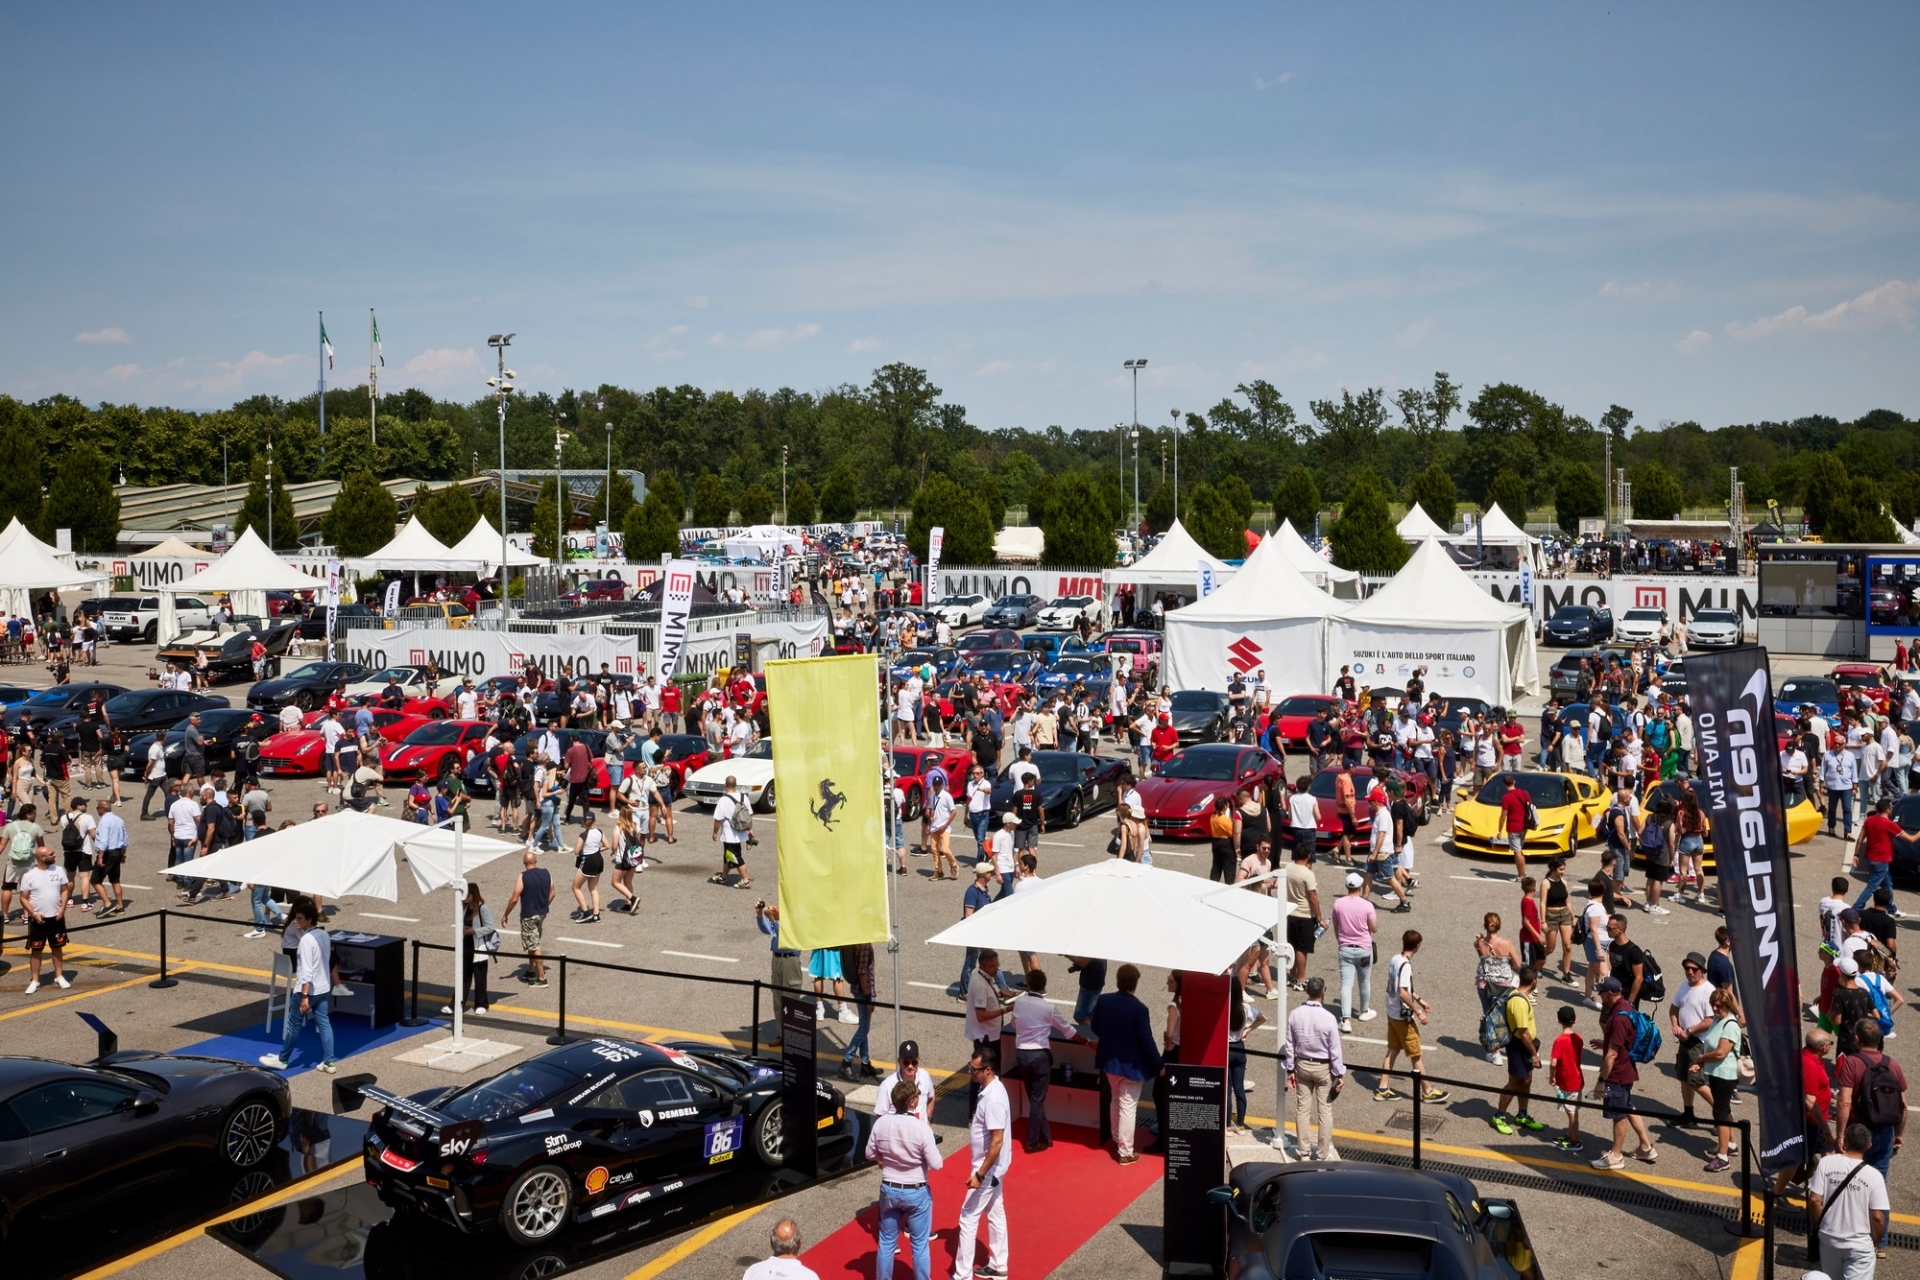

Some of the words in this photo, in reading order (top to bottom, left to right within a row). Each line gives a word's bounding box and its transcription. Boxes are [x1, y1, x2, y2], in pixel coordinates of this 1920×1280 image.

[131, 561, 183, 586] MIMO
[945, 575, 1032, 599] MIMO
[1679, 587, 1758, 622] MIM
[661, 611, 687, 676] MIMO
[1353, 650, 1375, 658] SUZUKI
[1376, 649, 1381, 658] È
[1382, 651, 1403, 659] L'AUTO
[1404, 652, 1424, 660] DELLO
[1425, 653, 1445, 661] SPORT
[1446, 653, 1475, 661] ITALIANO
[351, 649, 387, 670] IMO
[429, 650, 485, 675] MIMO
[530, 654, 590, 678] MIMO
[686, 650, 728, 674] MIMO
[568, 1089, 591, 1106] FERRARI
[590, 1072, 616, 1091] BUDAPEST
[658, 1106, 699, 1121] DEMBELL
[441, 1138, 471, 1157] sky
[547, 1146, 563, 1157] Tech
[562, 1139, 582, 1152] Group
[711, 1129, 734, 1154] 86
[663, 1181, 683, 1193] IVECO
